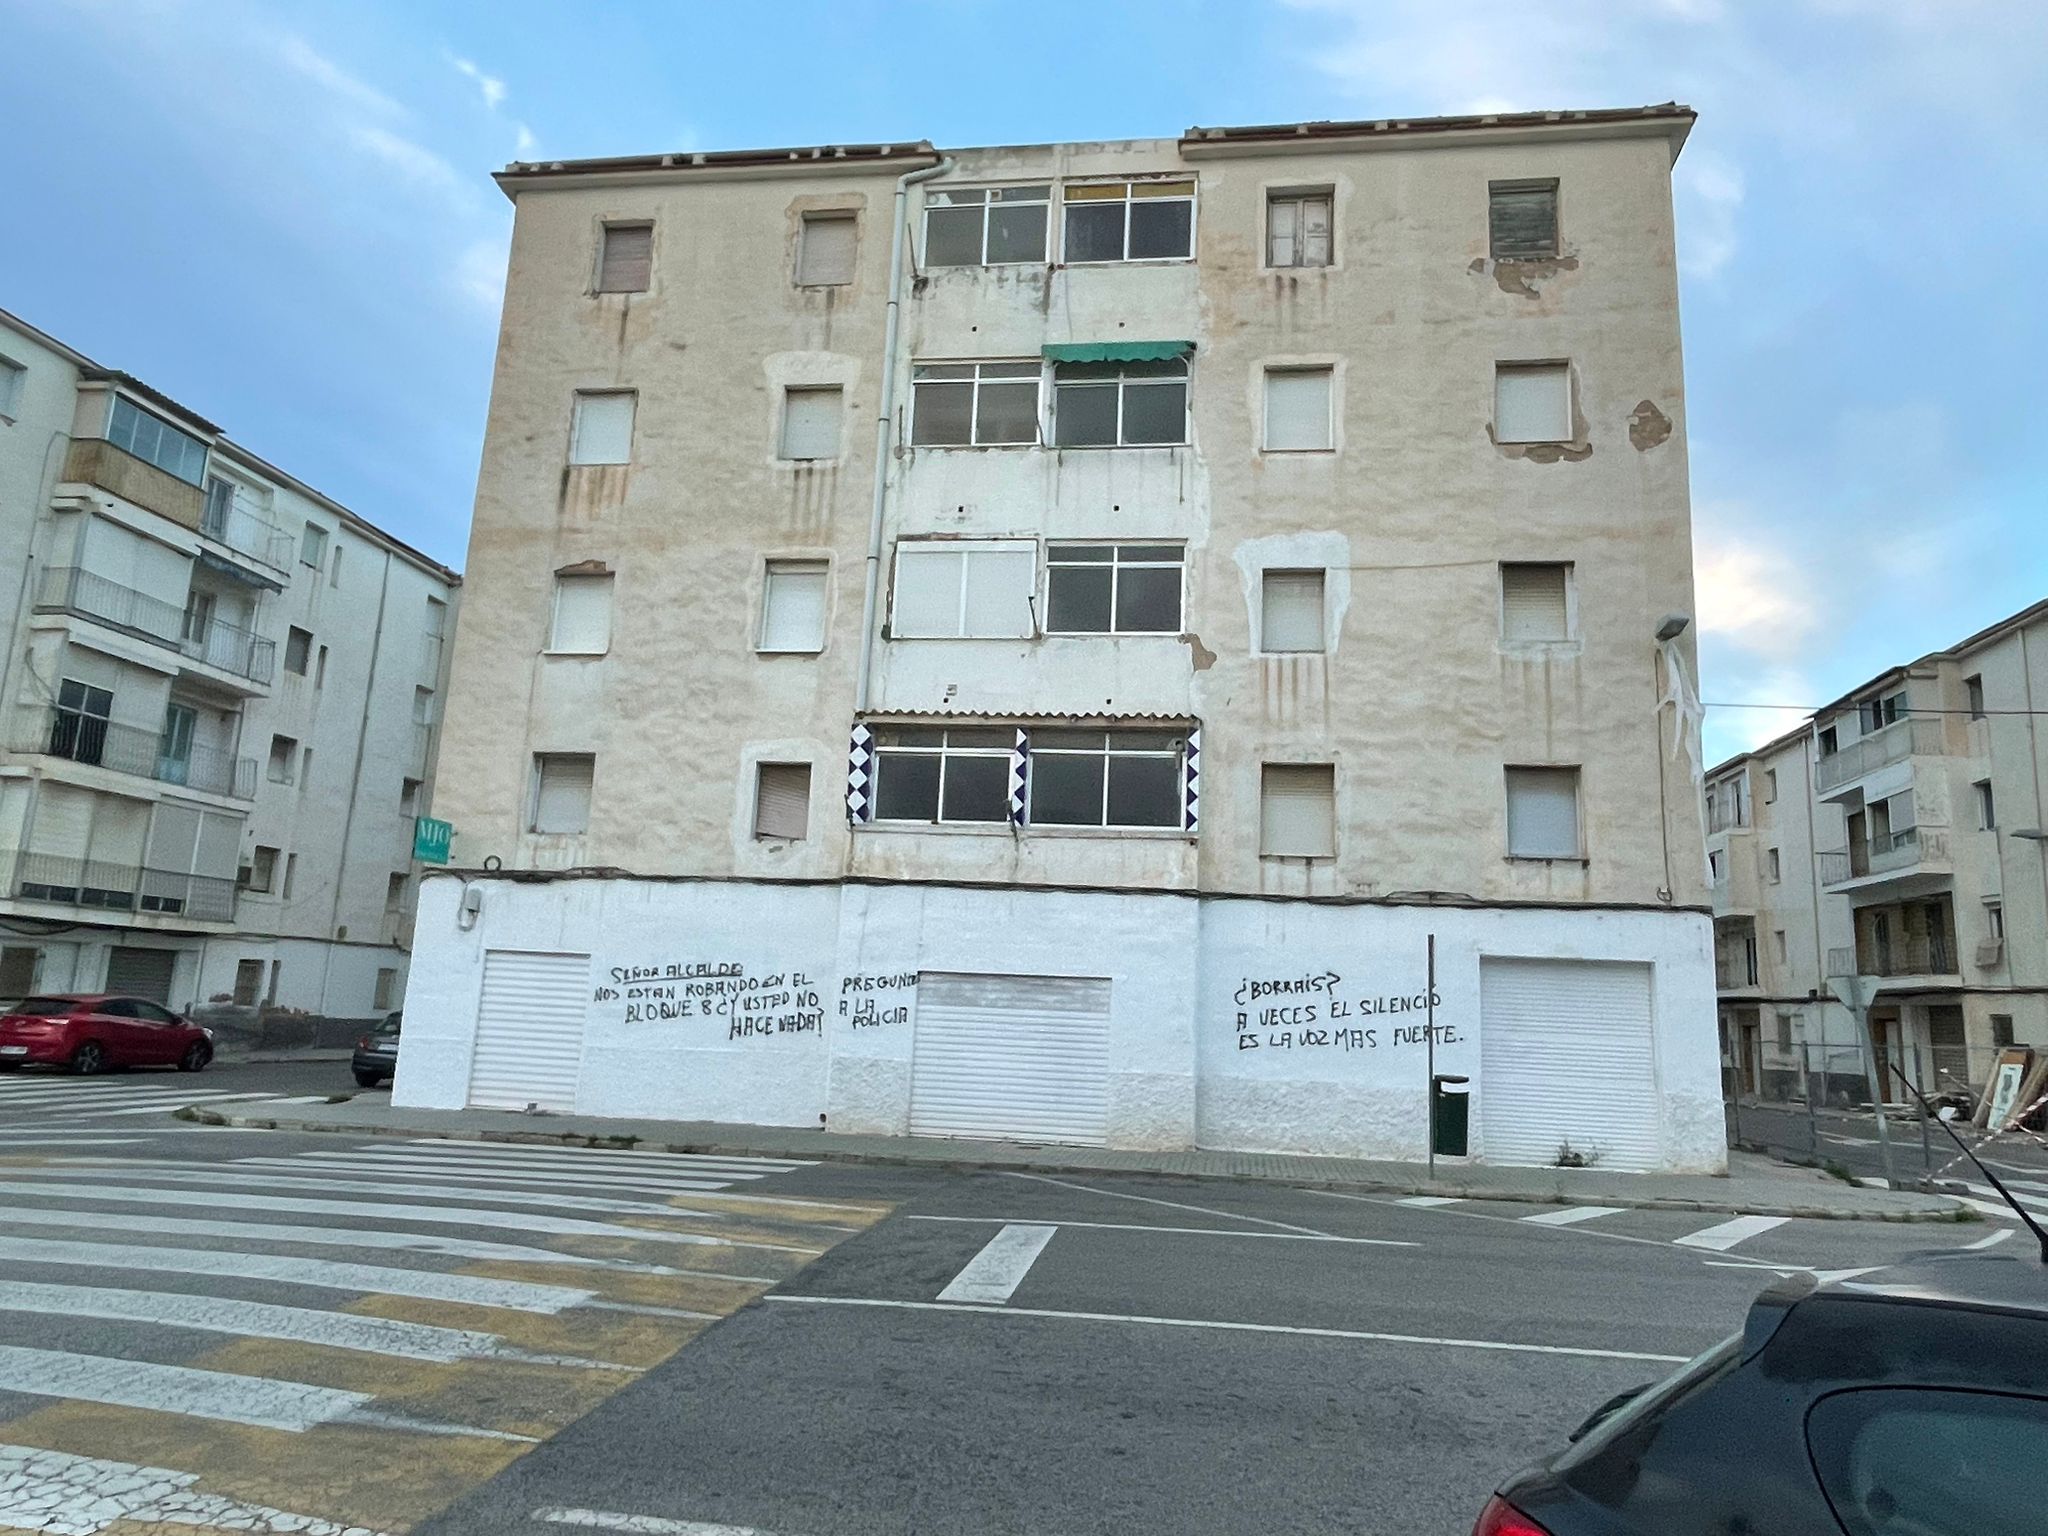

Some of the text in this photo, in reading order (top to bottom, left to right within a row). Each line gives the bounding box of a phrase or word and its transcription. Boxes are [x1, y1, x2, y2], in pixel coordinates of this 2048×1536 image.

[666, 963, 743, 977] ALCALDE
[594, 973, 814, 1001] NOS ESTAN ROBANDO EN EL
[625, 1000, 693, 1023] BLOQUE
[743, 991, 790, 1010] USTED
[797, 989, 818, 1008] NO
[839, 998, 875, 1016] A LA
[852, 1007, 907, 1029] POLICIA
[1237, 1012, 1247, 1032] A
[1259, 1005, 1316, 1025] VECES
[1330, 1001, 1351, 1018] EL
[729, 1016, 773, 1040] HACE
[1240, 1034, 1258, 1050] ES
[1270, 1032, 1292, 1048] LA
[1300, 1029, 1329, 1046] VOZ
[1334, 1028, 1377, 1052] MAS
